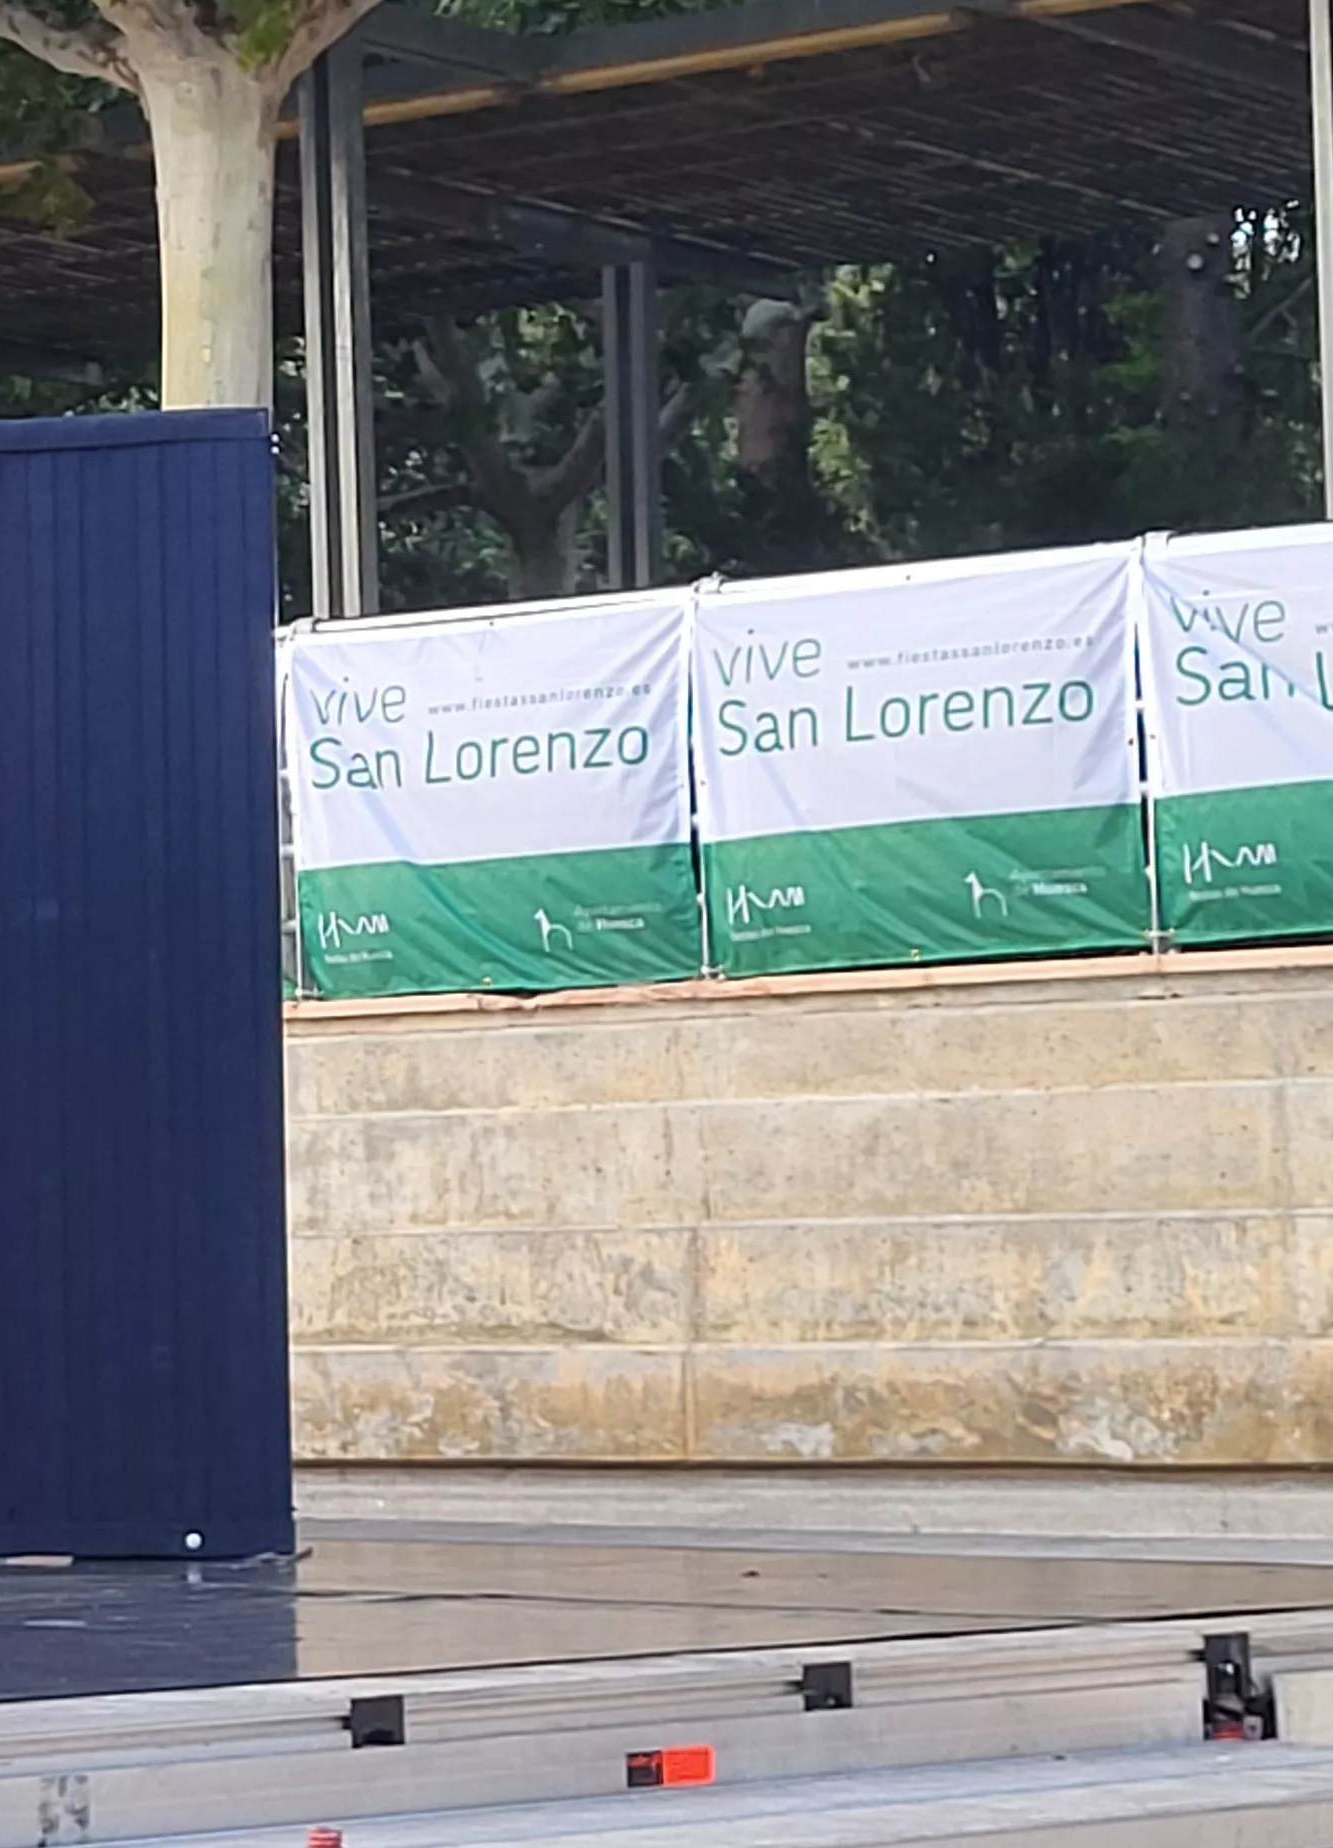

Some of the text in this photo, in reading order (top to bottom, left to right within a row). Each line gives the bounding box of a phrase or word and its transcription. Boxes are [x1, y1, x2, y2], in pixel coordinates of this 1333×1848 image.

[714, 628, 1094, 687] vive www.fiestassanlorenzo.es
[310, 676, 651, 726] vive www.fiestassanlorenzo.es
[718, 677, 1095, 757] San Lorenzo
[310, 725, 650, 790] San Lorenzo
